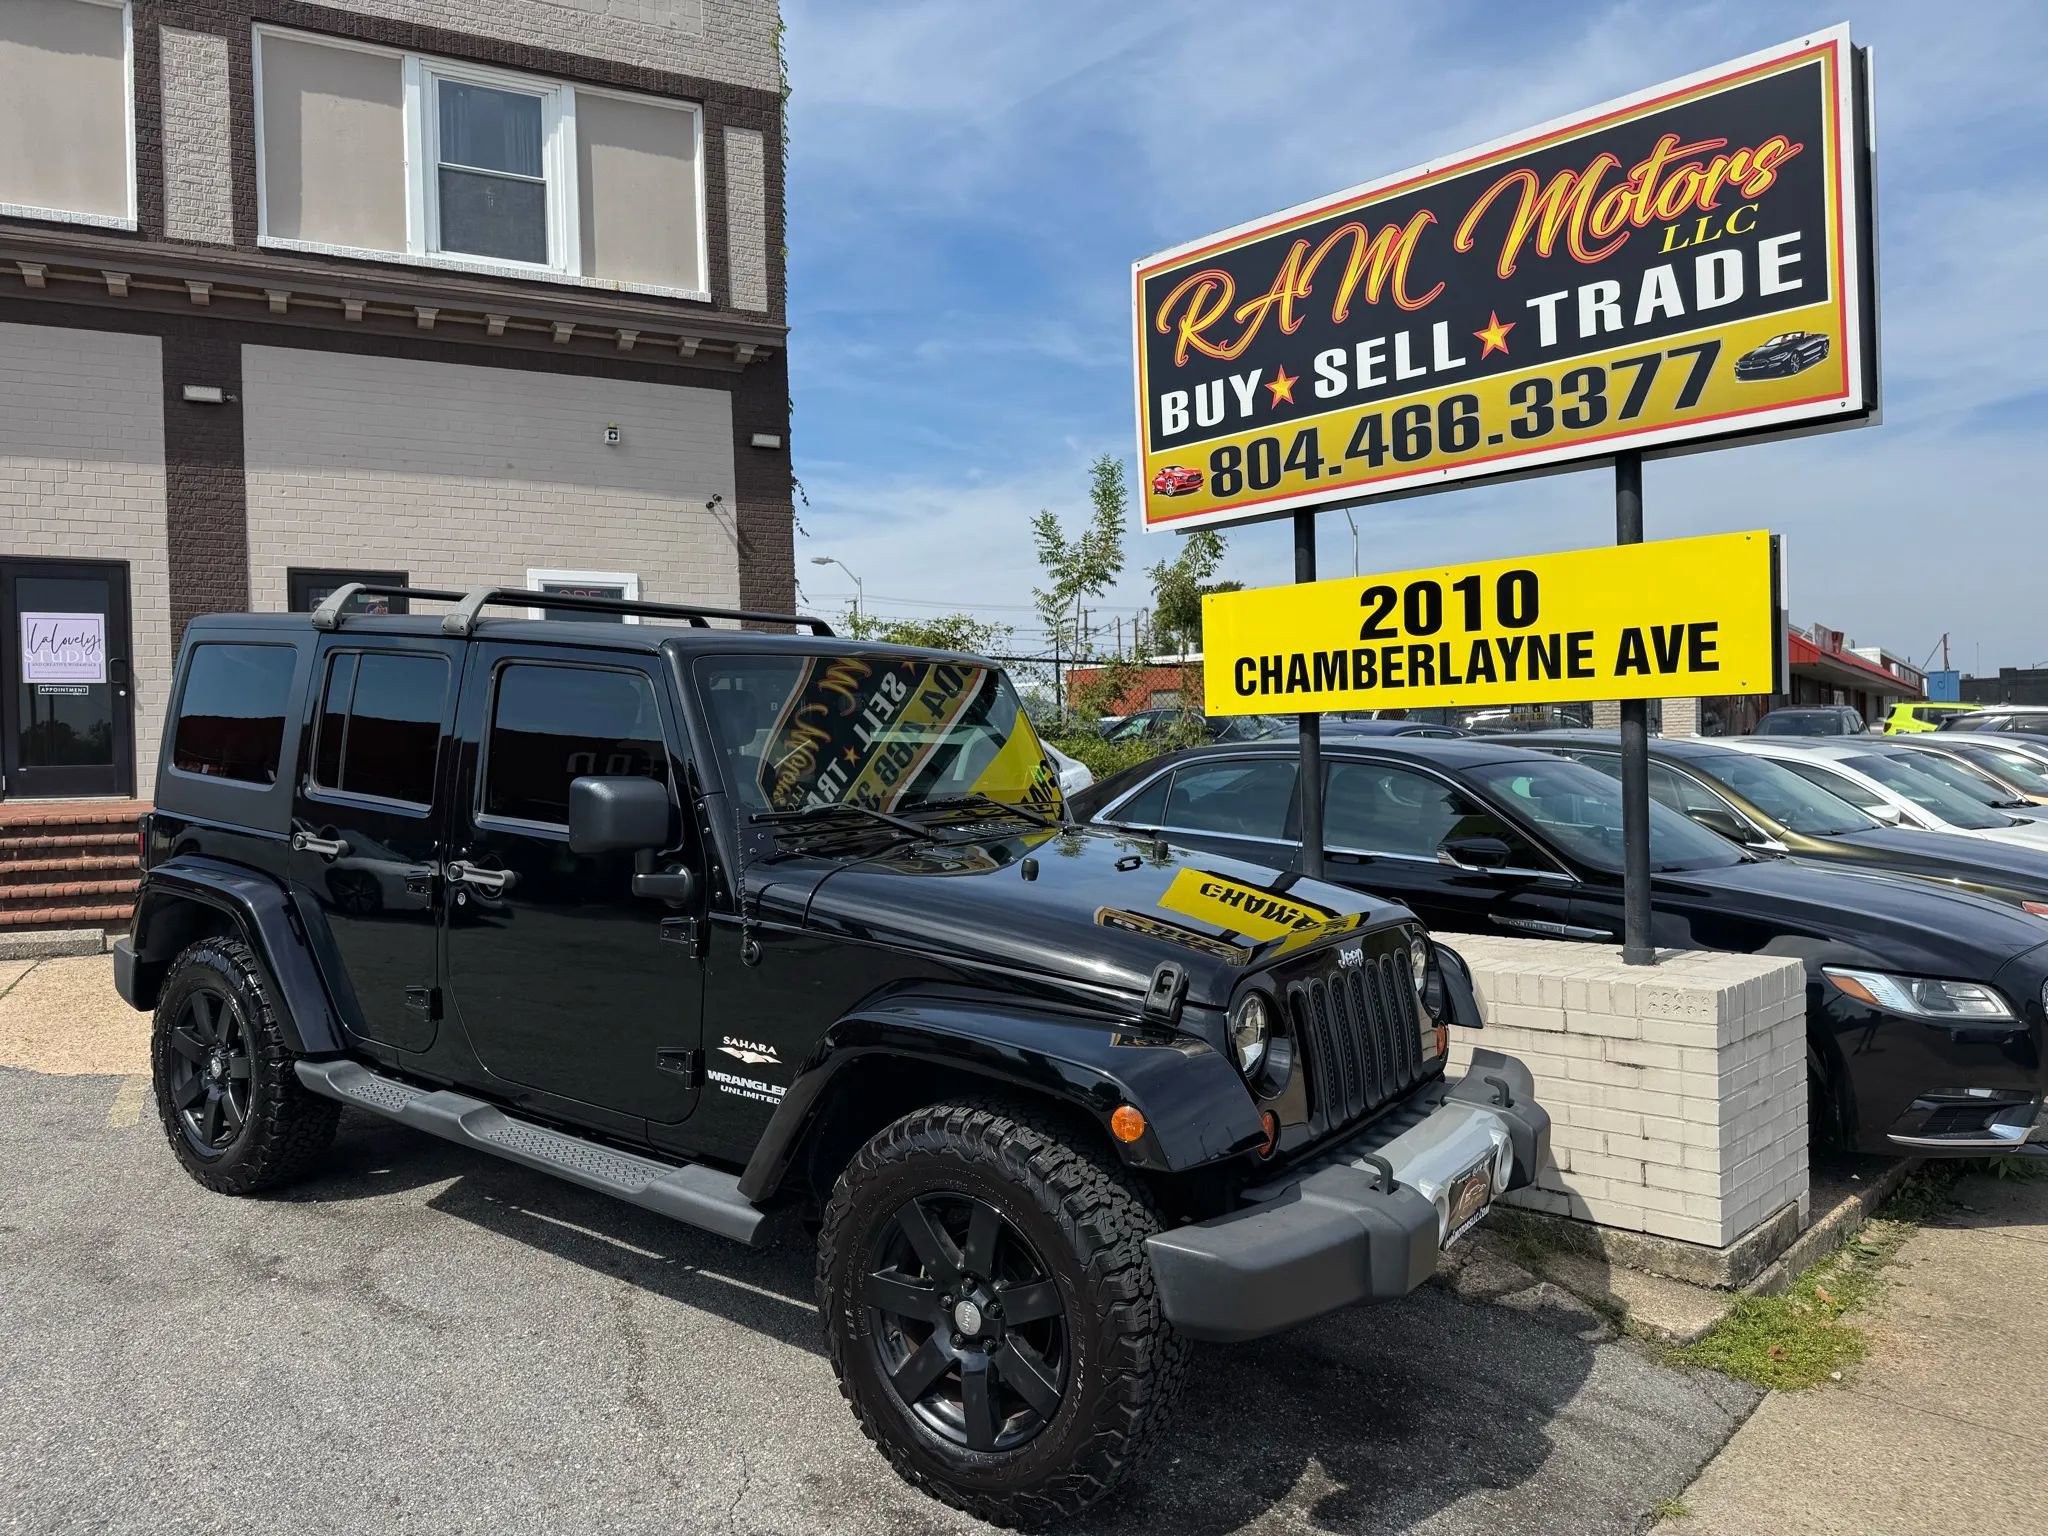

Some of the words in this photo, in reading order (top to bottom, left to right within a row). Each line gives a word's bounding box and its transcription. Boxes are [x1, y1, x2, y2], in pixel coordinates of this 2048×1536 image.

[1156, 209, 1446, 366] RAM
[1455, 133, 1804, 280] Motors
[1658, 204, 1759, 254] LLC
[1160, 368, 1263, 437] BUY
[1314, 322, 1467, 398] SELL
[1527, 231, 1803, 348] TRADE
[1209, 339, 1723, 498] 804.466.3377
[1360, 569, 1540, 641] 2010
[24, 649, 103, 663] STUDIO
[1234, 631, 1595, 696] CHAMBERLAYNE
[1614, 621, 1720, 676] AVE
[1338, 948, 1363, 967] Jeep
[723, 1036, 777, 1055] SAHARA
[720, 1085, 780, 1104] UNLIMITED
